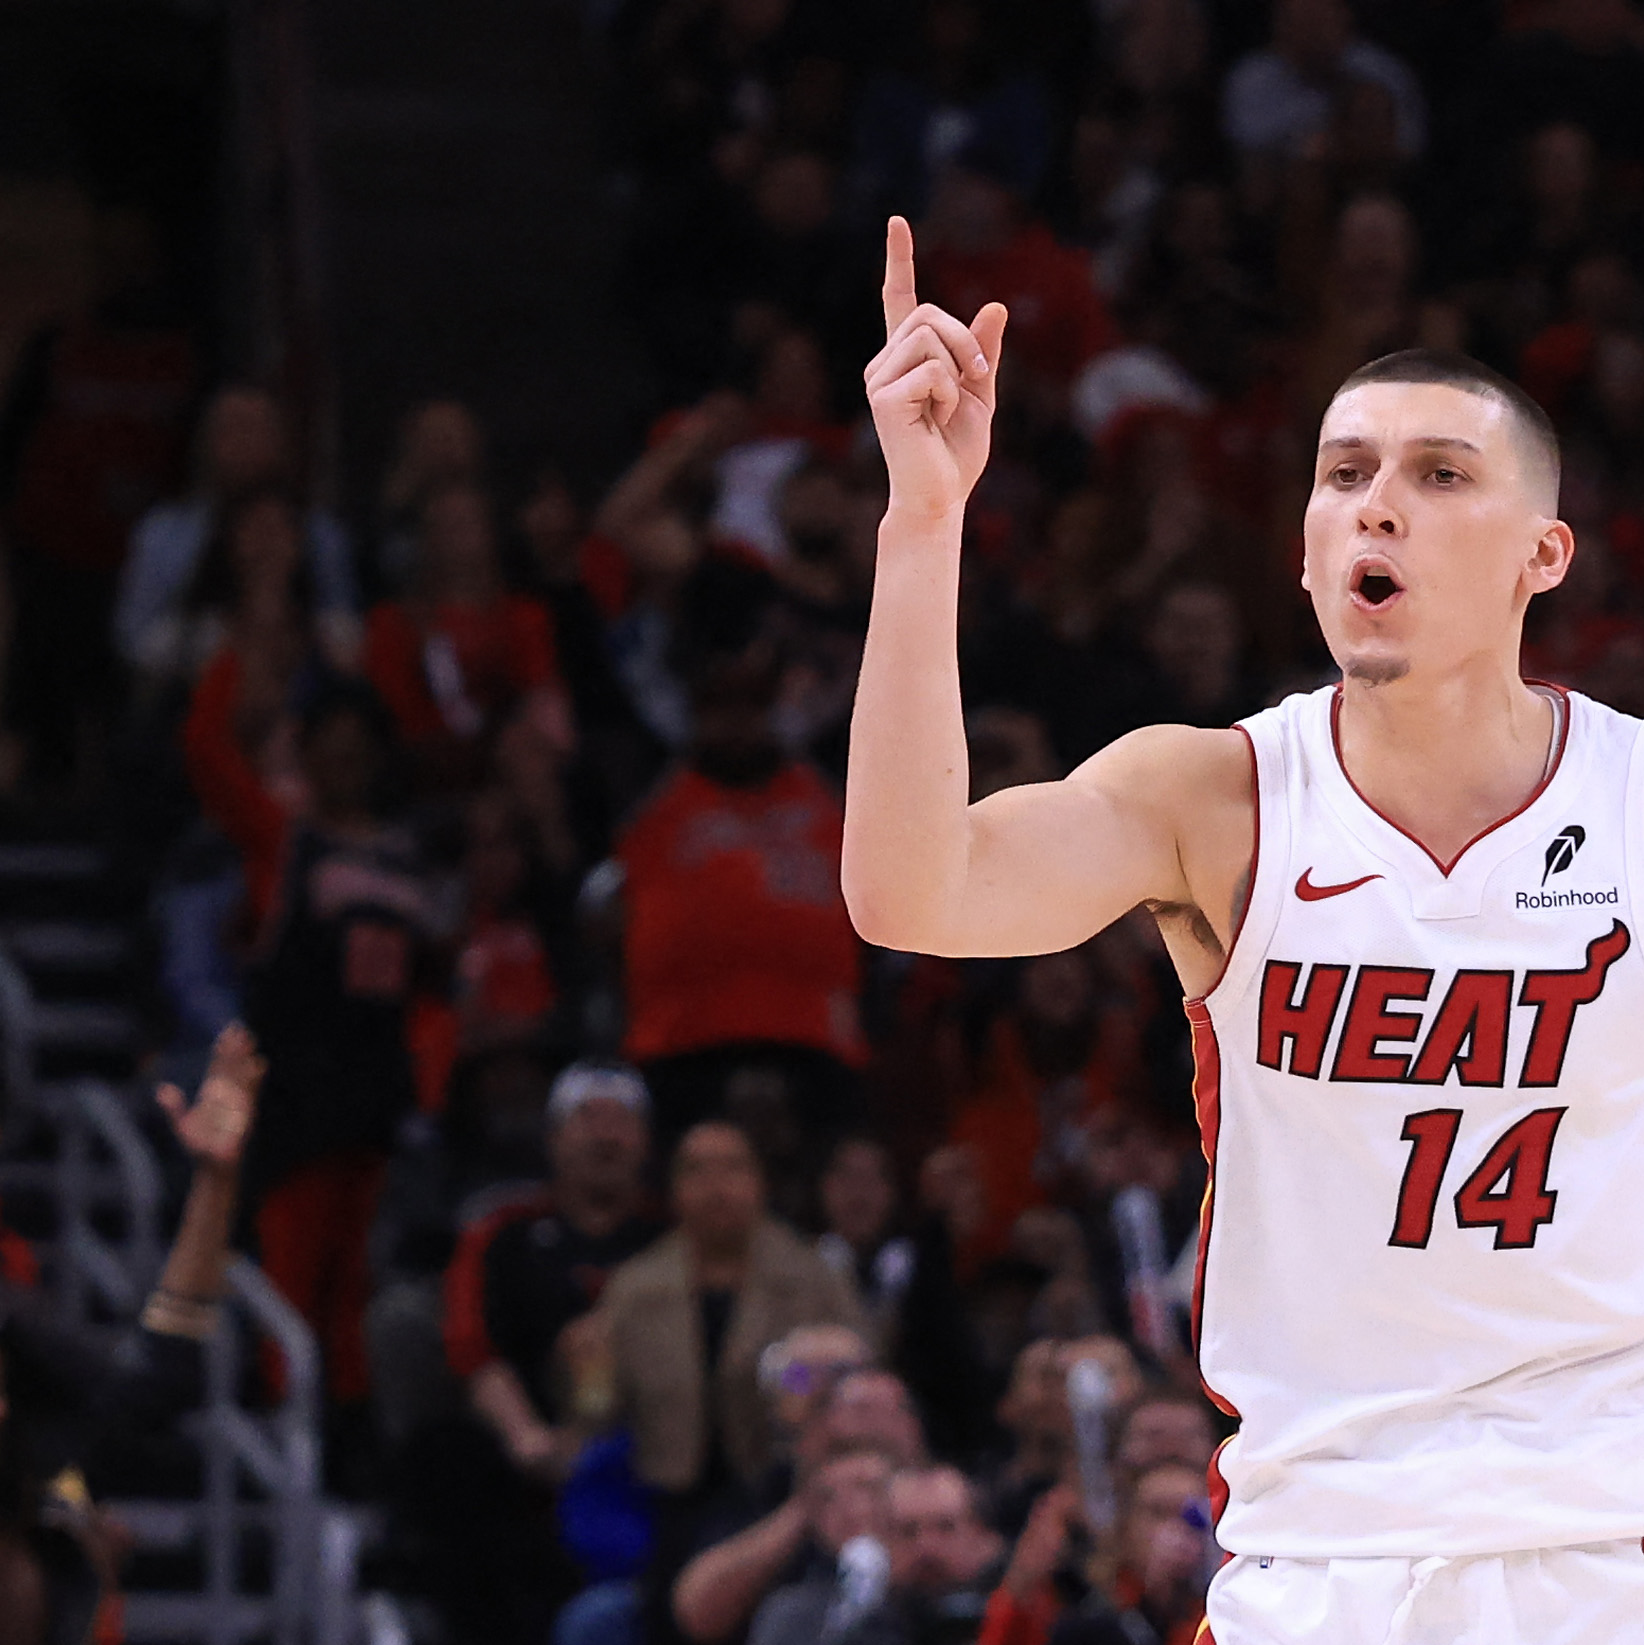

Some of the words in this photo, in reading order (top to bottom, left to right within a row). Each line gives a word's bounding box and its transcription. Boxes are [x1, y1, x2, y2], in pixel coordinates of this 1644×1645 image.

[1515, 887, 1619, 910] Robinhood
[1256, 917, 1631, 1089] HEAT
[1387, 1105, 1570, 1251] 14
